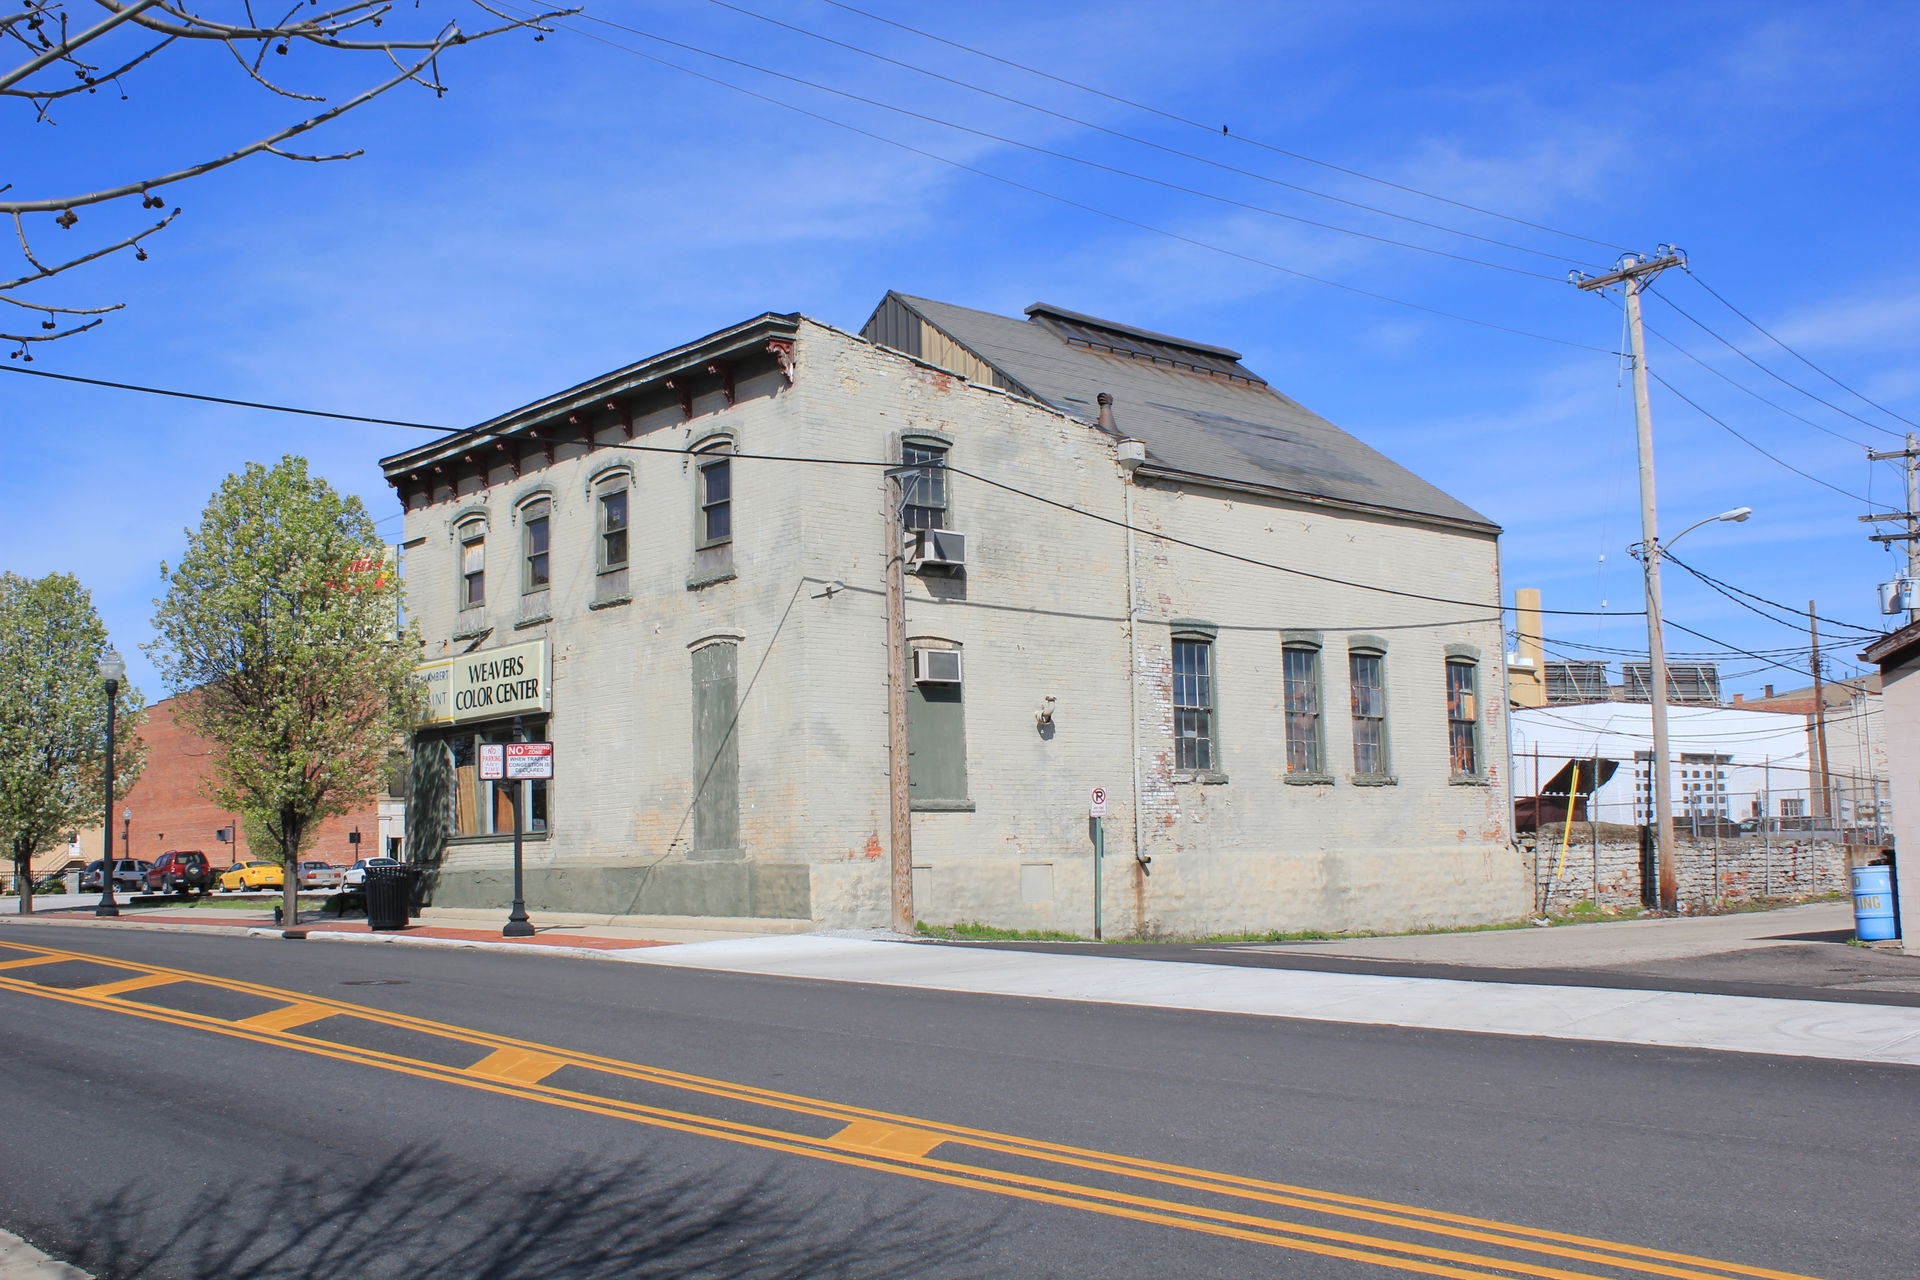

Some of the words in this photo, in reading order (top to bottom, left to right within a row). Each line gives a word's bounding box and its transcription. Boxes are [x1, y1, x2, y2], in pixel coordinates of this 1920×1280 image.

[468, 656, 524, 684] WEAVERS
[456, 686, 493, 710] COLOR
[496, 678, 539, 704] CENTER
[508, 746, 524, 755] NO
